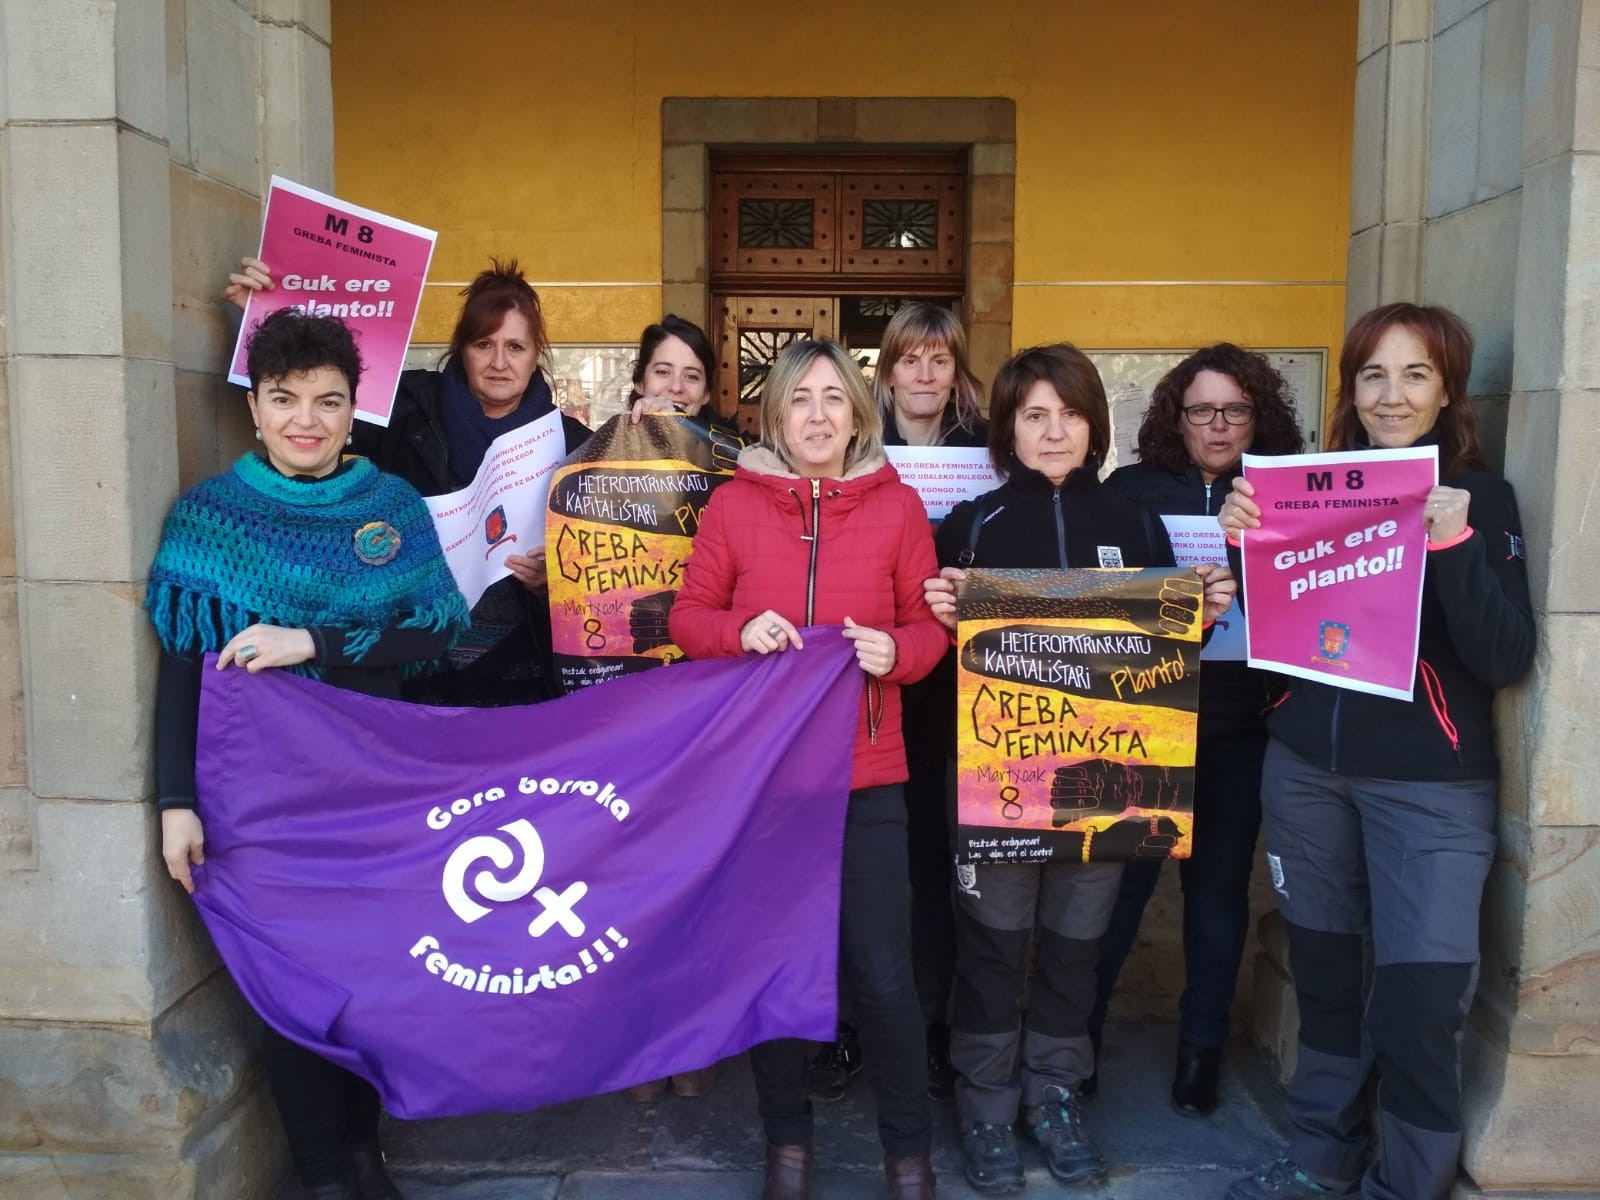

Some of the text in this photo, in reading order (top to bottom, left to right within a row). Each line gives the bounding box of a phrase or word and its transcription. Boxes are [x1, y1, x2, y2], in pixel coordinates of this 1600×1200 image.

[325, 213, 374, 244] M 8
[293, 227, 397, 267] GREBA FEMINISTA
[281, 275, 391, 293] Guk ere
[1306, 470, 1364, 492] M 8
[1274, 497, 1399, 511] GREBA FEMINISTA
[1274, 519, 1398, 570] Guk ere
[1290, 546, 1405, 600] planto!!
[563, 599, 624, 616] Martxoak
[584, 619, 606, 650] 8
[1110, 648, 1190, 700] Planto!
[977, 766, 1046, 784] Martxoak
[426, 777, 631, 830] Gora borroka
[1000, 786, 1023, 820] 8
